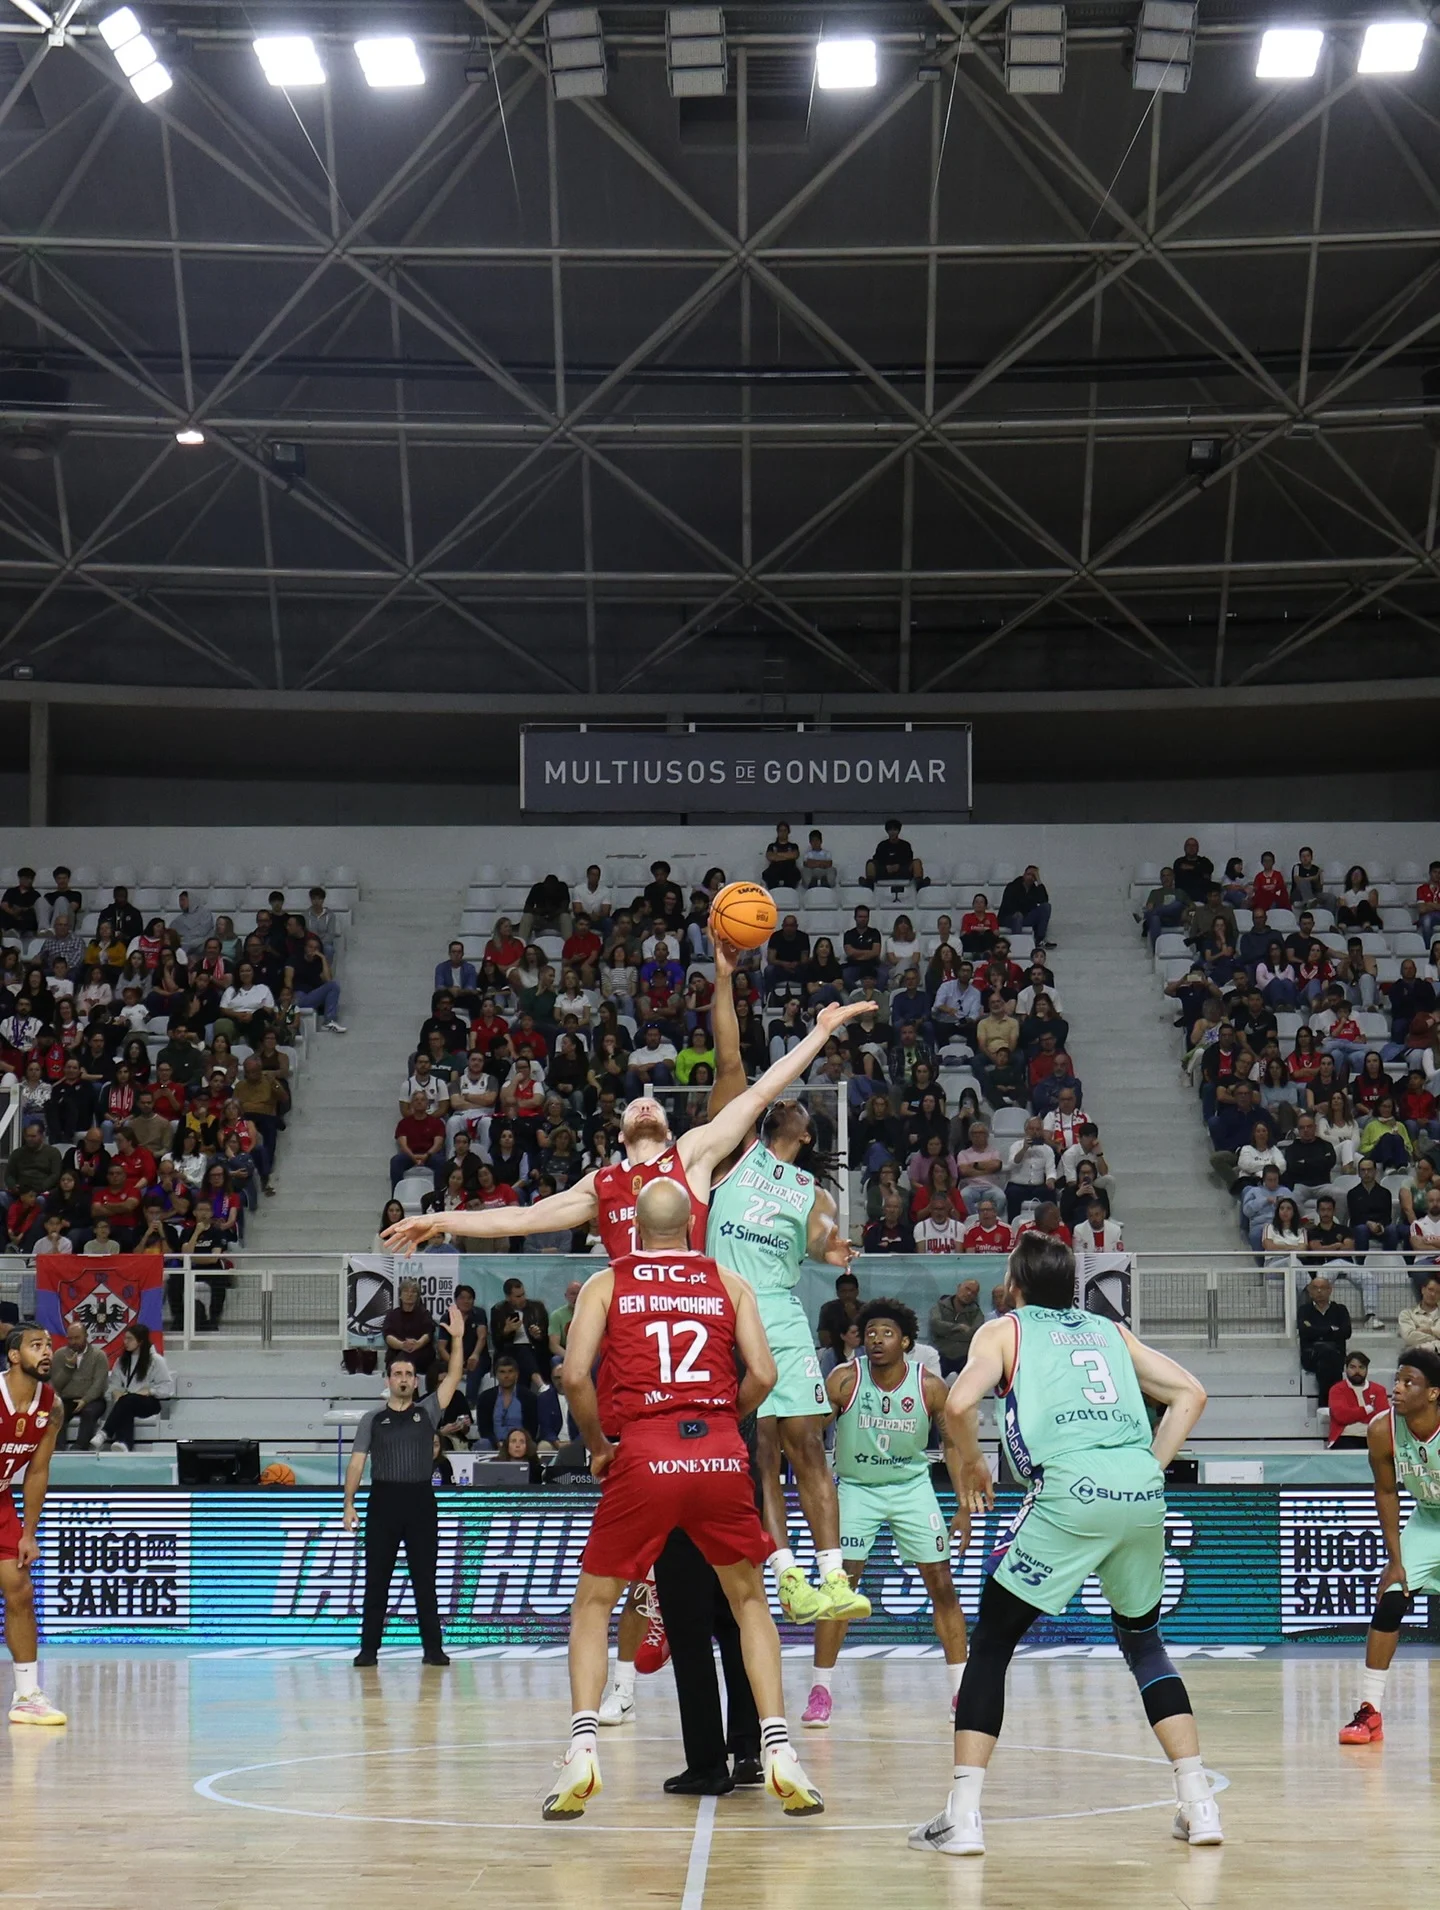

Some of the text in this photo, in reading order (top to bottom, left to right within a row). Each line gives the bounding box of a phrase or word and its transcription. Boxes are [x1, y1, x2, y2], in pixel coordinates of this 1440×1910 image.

[545, 760, 946, 784] MULTIUSOS DE GONDOMAR
[743, 1194, 782, 1228] 22
[734, 1223, 790, 1252] Simoldes
[633, 1264, 707, 1285] GTC.pt
[618, 1295, 645, 1314] BEN
[645, 1320, 711, 1384] 12
[1070, 1350, 1119, 1405] 3
[877, 1433, 891, 1453] 0
[649, 1458, 741, 1474] MONEYFLIX
[1096, 1487, 1164, 1502] SUTAFE
[929, 1512, 940, 1531] 0
[59, 1529, 141, 1573] HUGO
[1014, 1547, 1053, 1574] GRUPO
[1294, 1529, 1378, 1573] HUGO
[1009, 1560, 1048, 1587] PS
[58, 1576, 177, 1617] SANTOS
